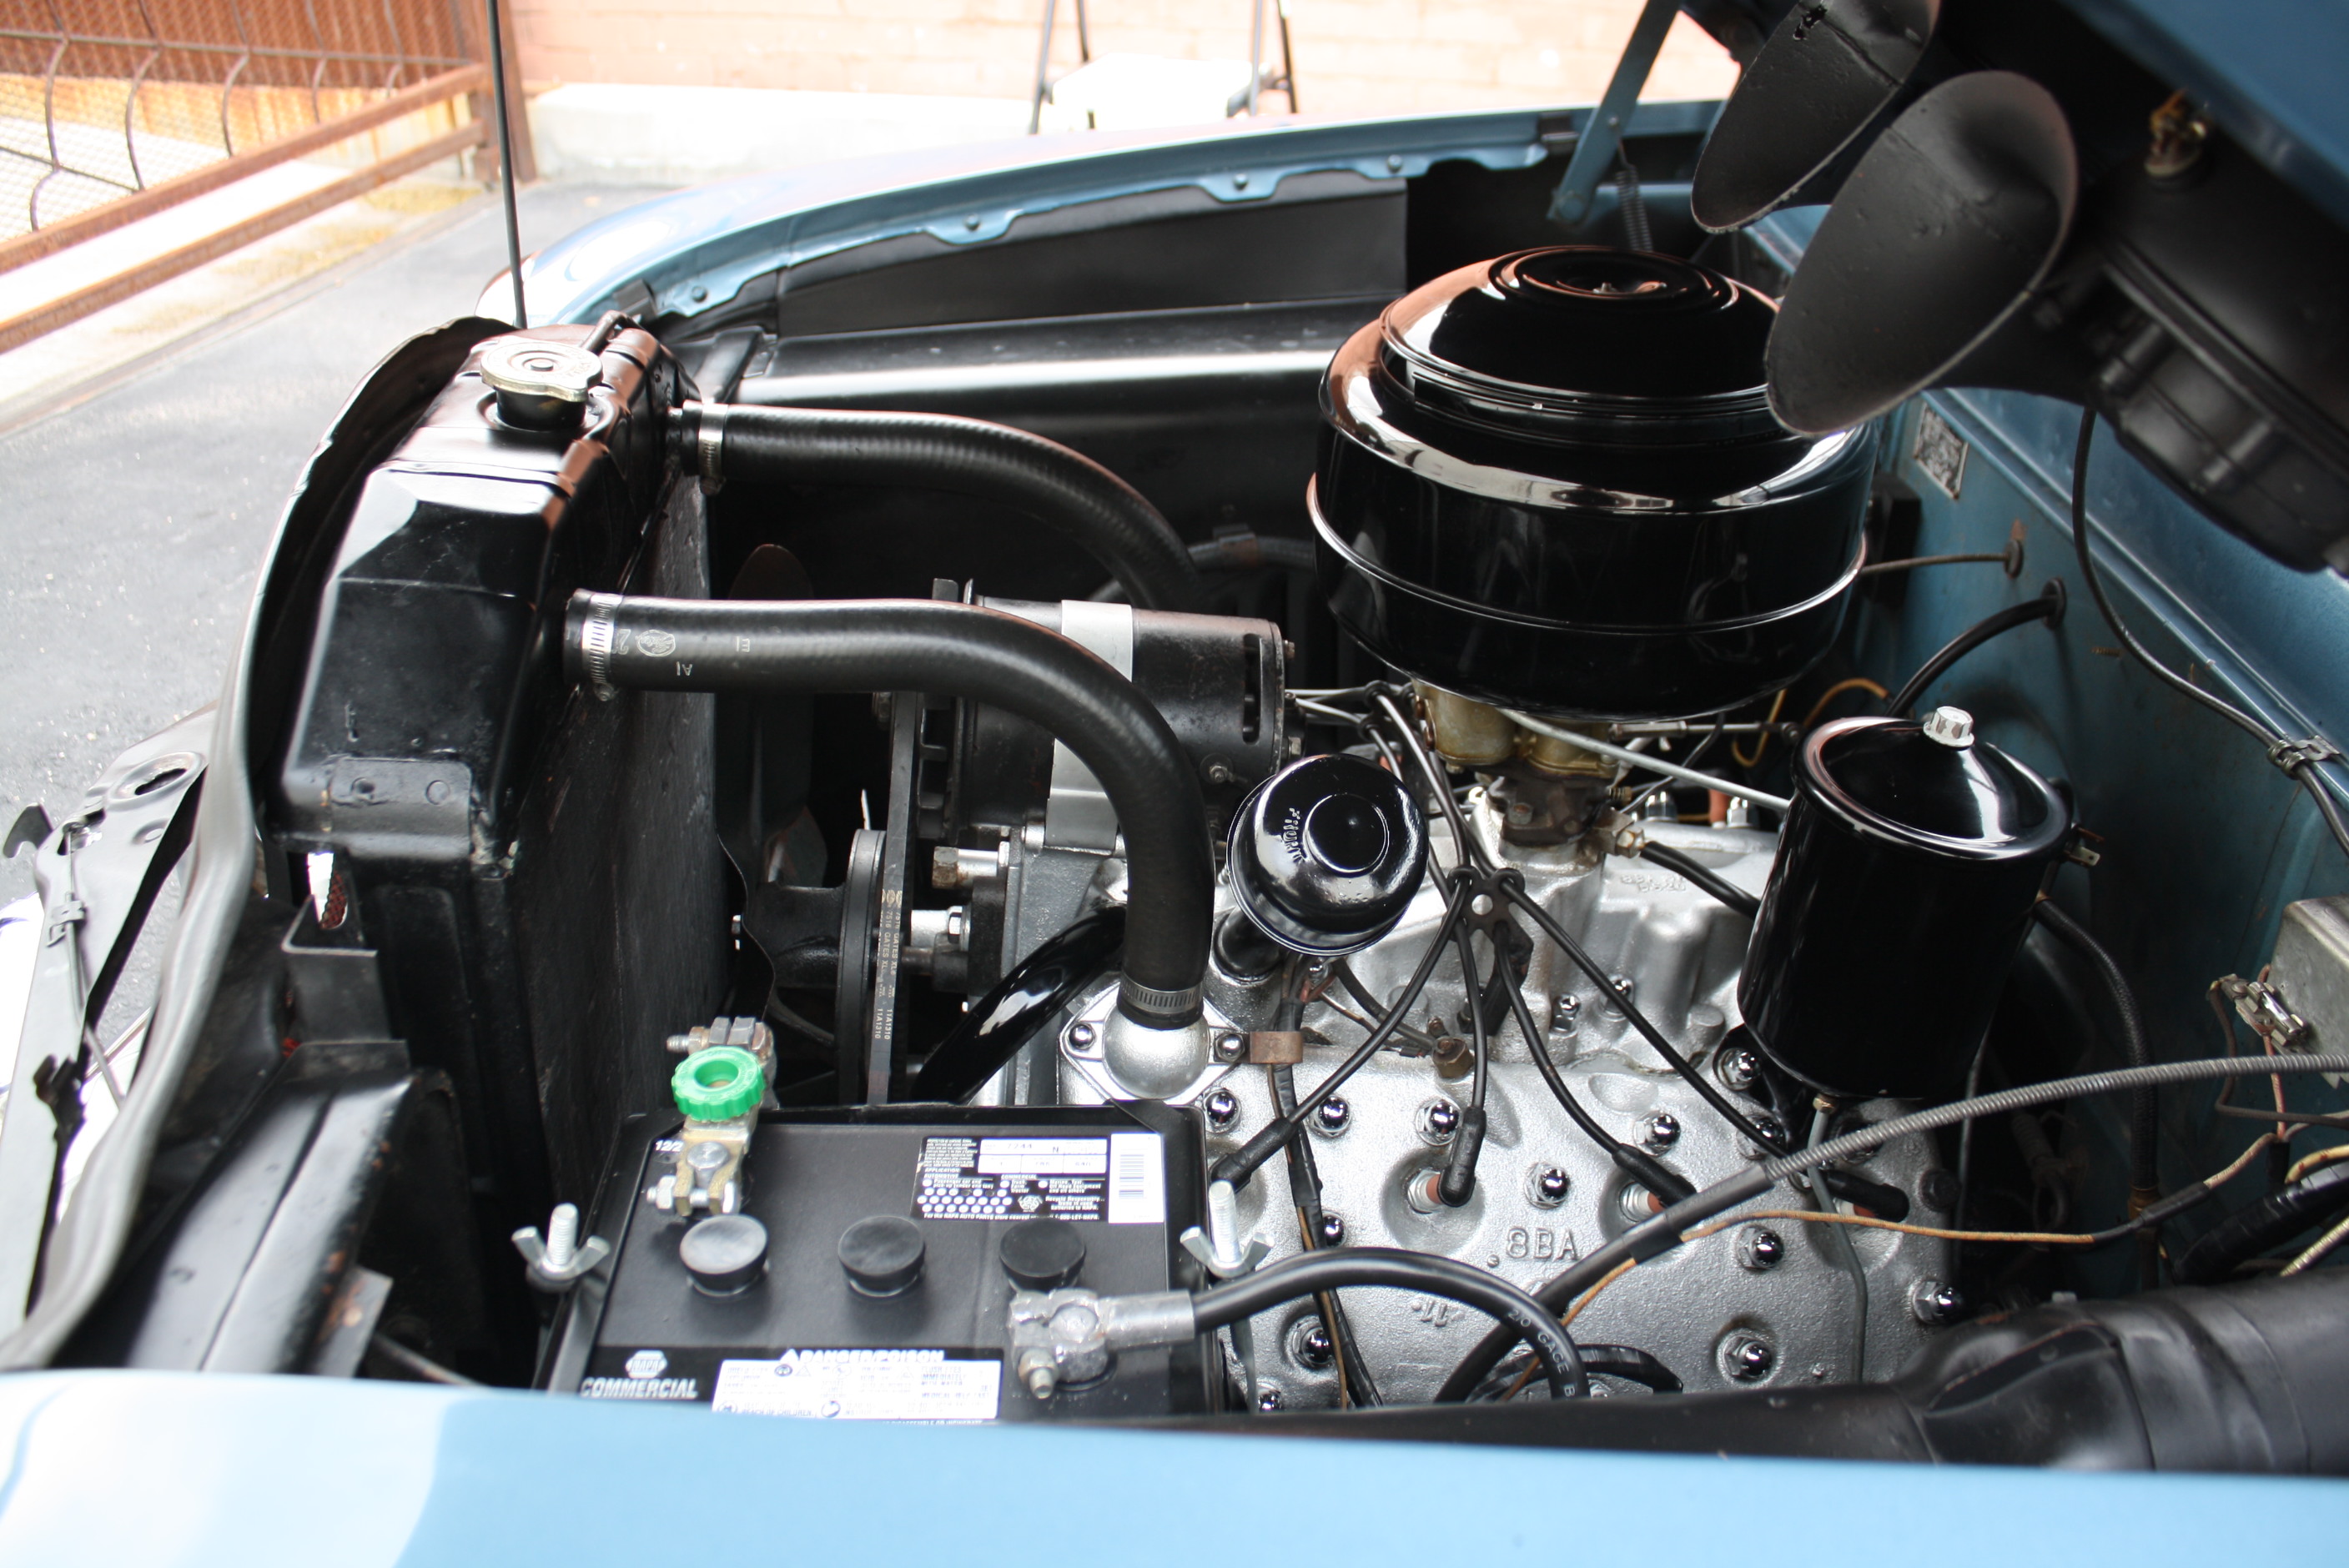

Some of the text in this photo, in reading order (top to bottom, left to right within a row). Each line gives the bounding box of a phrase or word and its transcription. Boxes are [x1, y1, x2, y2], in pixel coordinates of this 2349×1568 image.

[885, 911, 893, 928] 7516
[883, 932, 892, 957] GATES
[890, 932, 899, 958] GATES
[874, 1008, 884, 1039] 11A1310
[883, 1008, 893, 1040] 11A1310
[1506, 1227, 1578, 1261] 8BA
[580, 1377, 699, 1400] COMMERCIAL
